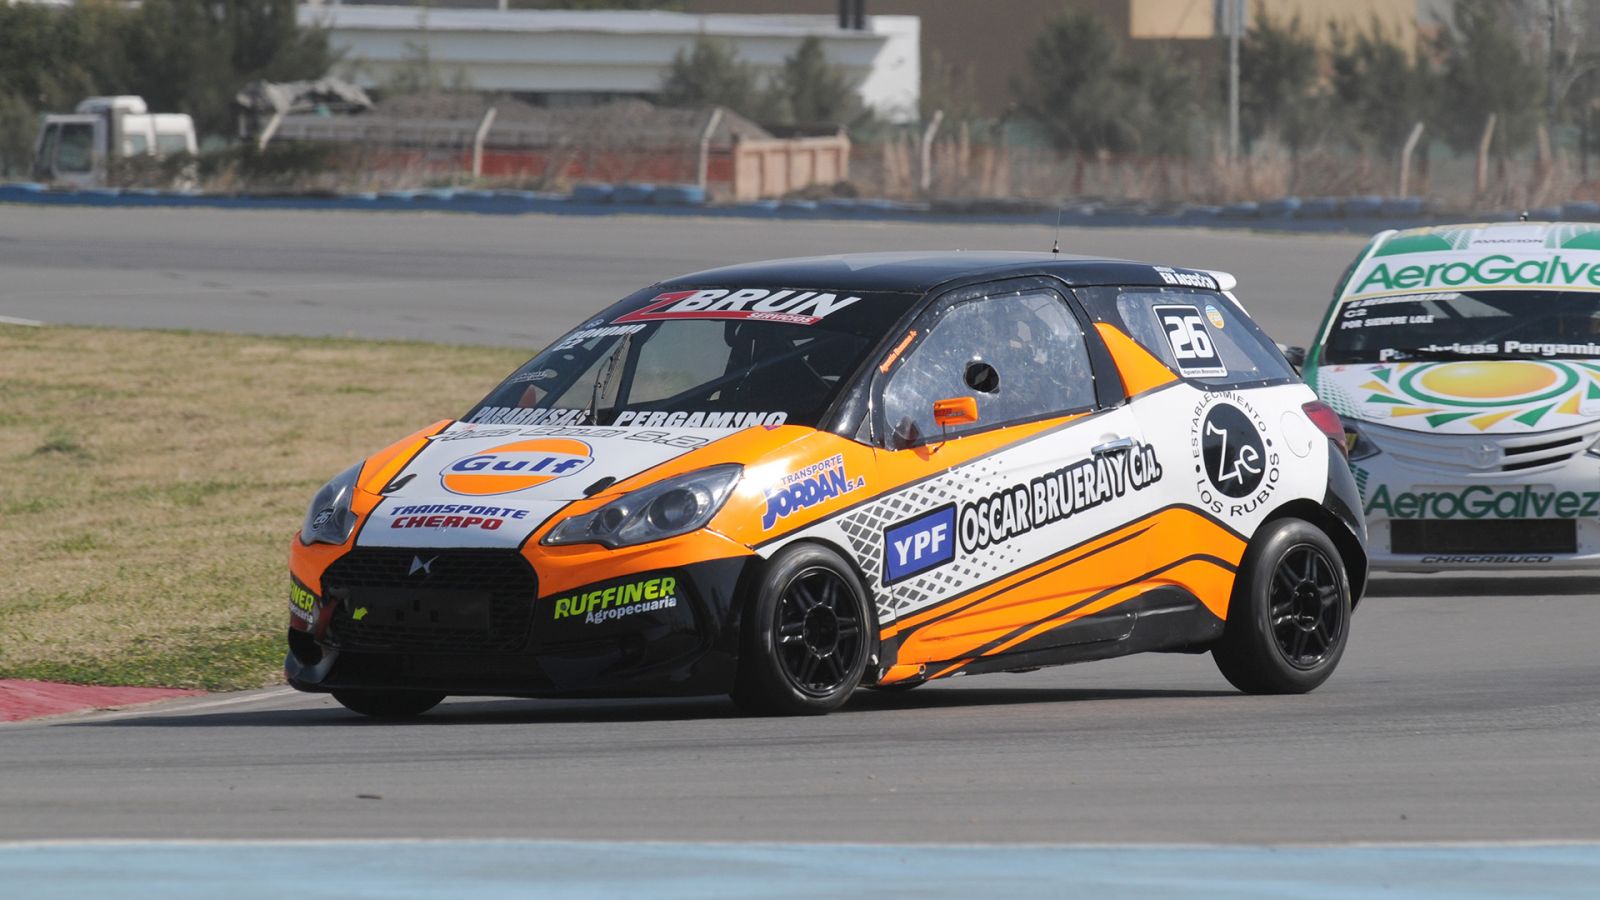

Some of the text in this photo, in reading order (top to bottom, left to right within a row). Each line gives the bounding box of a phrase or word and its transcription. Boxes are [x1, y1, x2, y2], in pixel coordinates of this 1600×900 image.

[1164, 315, 1214, 359] 26
[451, 456, 585, 473] Gulf
[781, 455, 843, 485] TRANSPORTE
[762, 466, 848, 530] JORDAN
[960, 486, 1031, 553] OSCAR
[1031, 457, 1112, 528] BRUERA
[1106, 452, 1126, 497] Y
[1197, 453, 1280, 517] LOS RUBIOS
[1366, 484, 1600, 519] AeroGalvez
[390, 504, 530, 519] TRANSPORTE
[391, 516, 504, 530] CHERPO
[894, 522, 948, 567] YPF
[554, 577, 676, 619] RUFFINER
[585, 596, 677, 624] Agropecuaria
